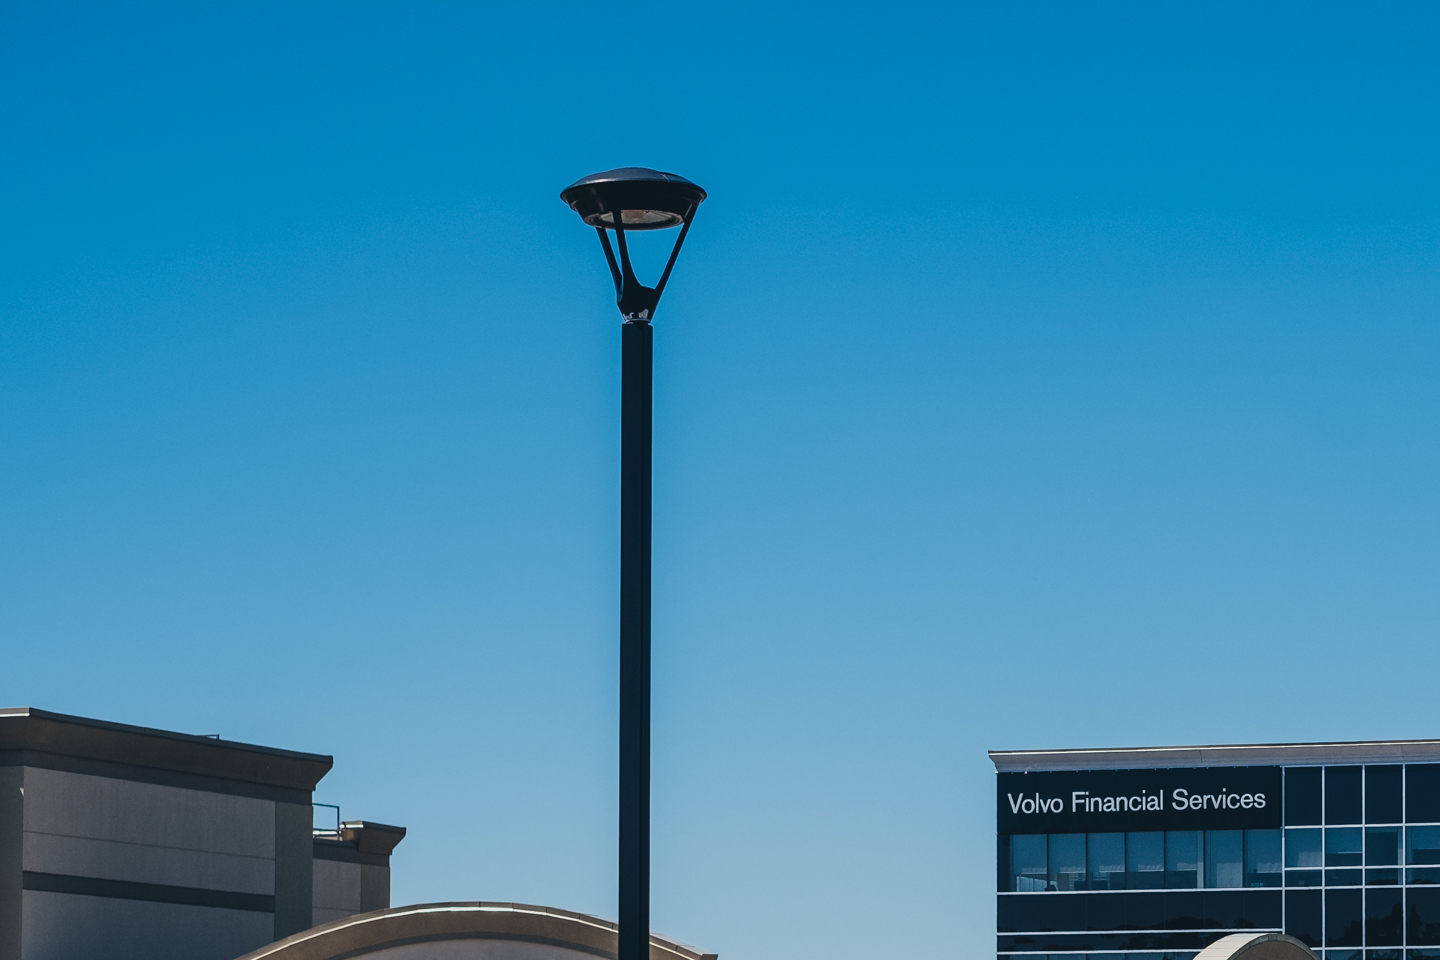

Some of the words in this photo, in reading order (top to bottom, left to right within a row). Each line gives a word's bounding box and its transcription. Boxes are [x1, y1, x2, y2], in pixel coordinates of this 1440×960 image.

[1008, 793, 1063, 814] Volvo
[1071, 790, 1164, 812] Financial
[1172, 788, 1266, 810] Services
